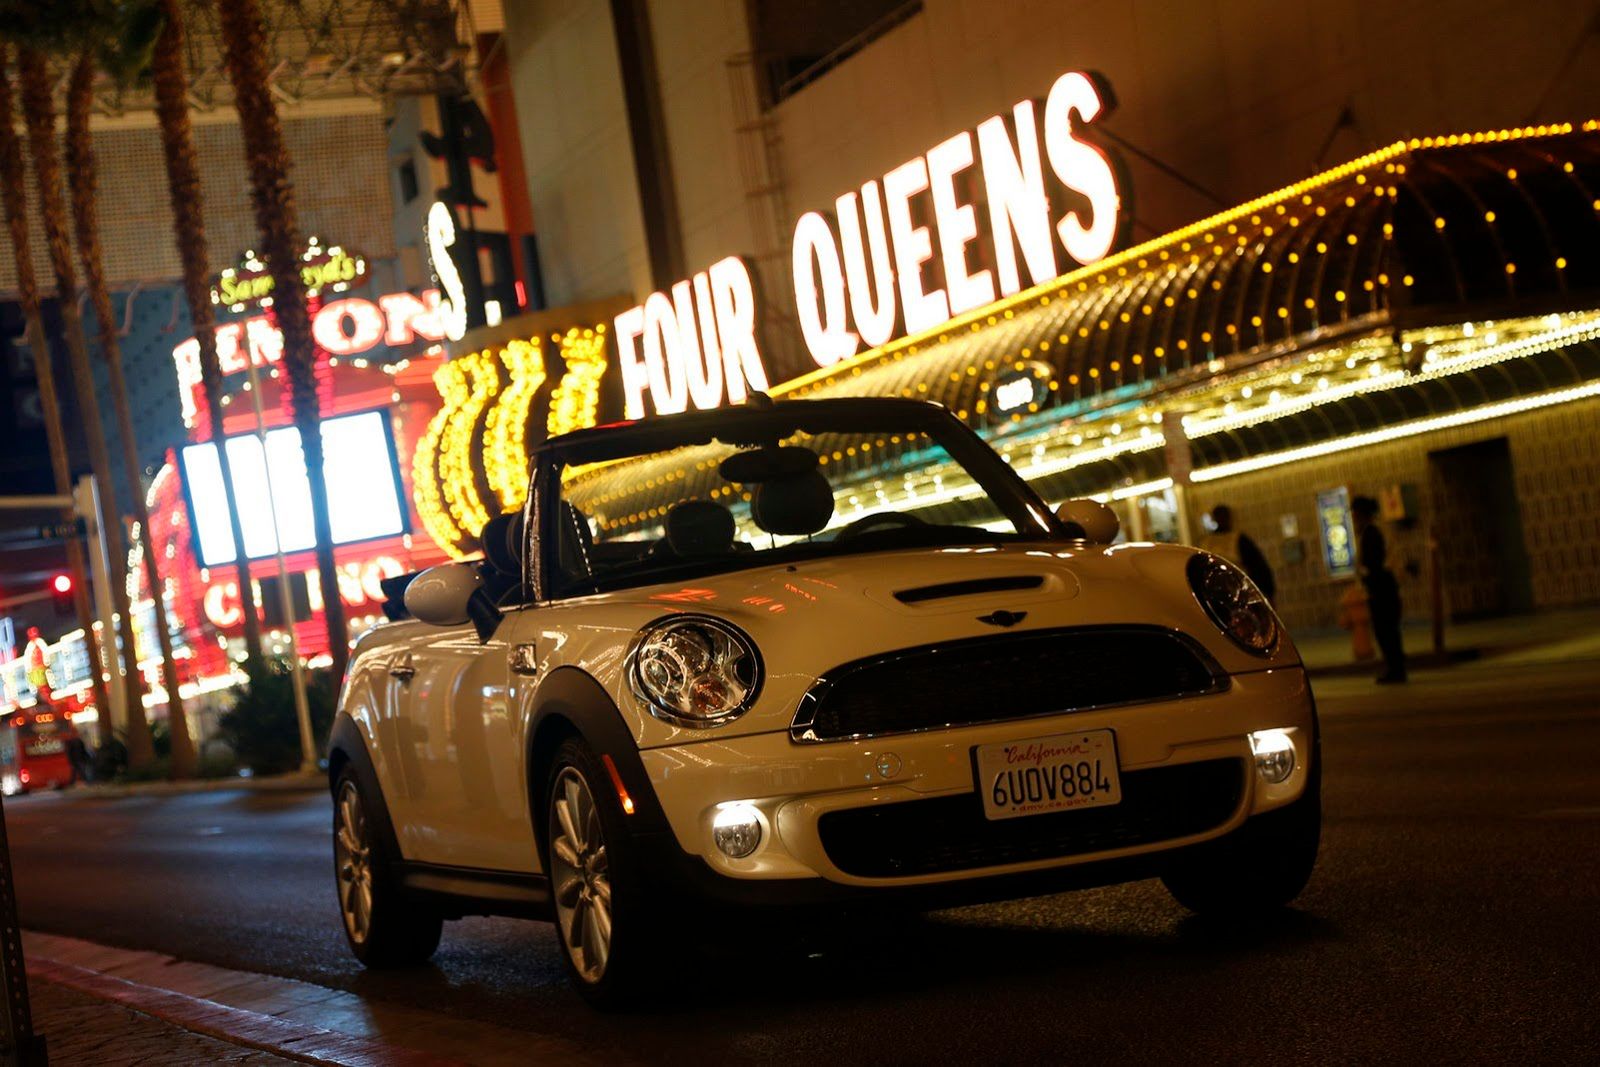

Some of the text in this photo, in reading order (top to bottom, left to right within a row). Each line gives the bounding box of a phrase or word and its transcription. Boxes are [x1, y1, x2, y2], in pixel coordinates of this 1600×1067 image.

[614, 71, 1118, 420] FOUR QUEENS
[1007, 744, 1089, 765] California
